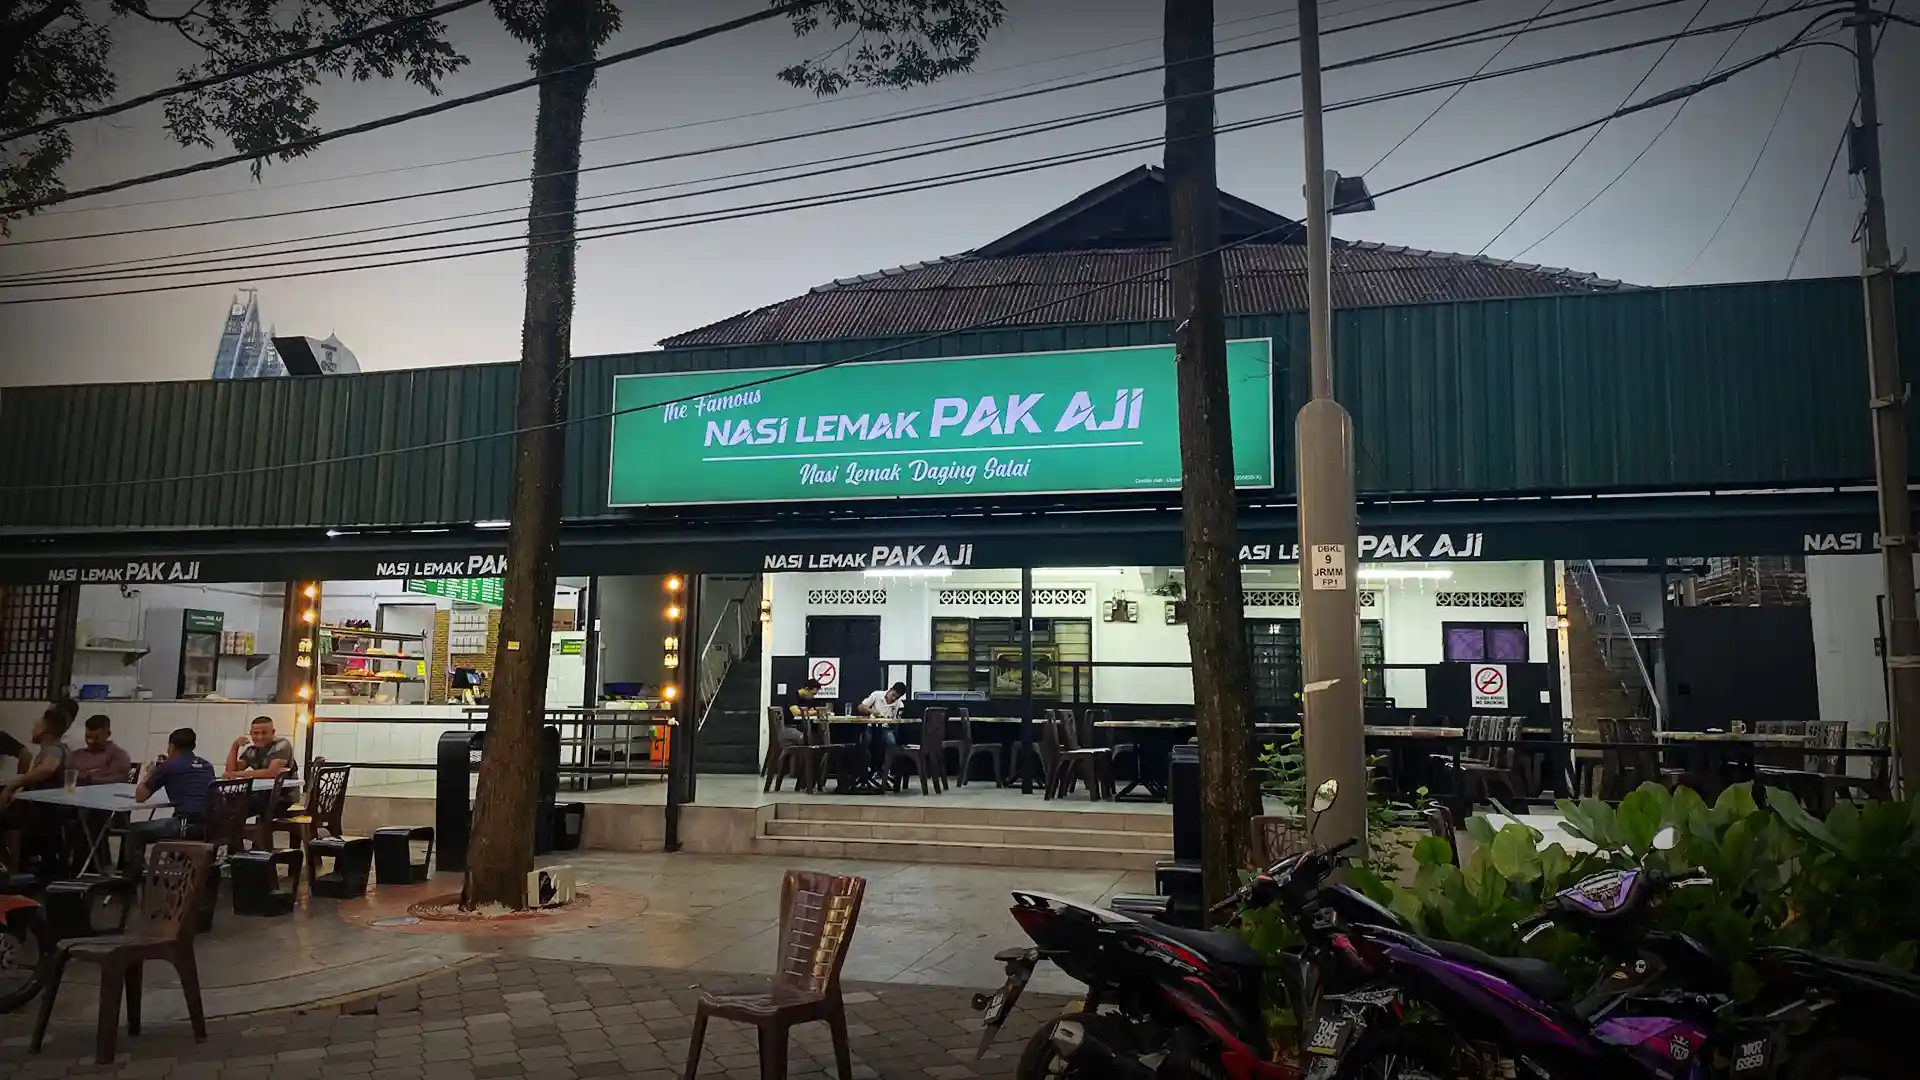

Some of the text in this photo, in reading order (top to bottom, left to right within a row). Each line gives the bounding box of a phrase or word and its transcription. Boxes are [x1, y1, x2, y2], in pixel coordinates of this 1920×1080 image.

[661, 389, 761, 424] The Famous
[704, 388, 1144, 447] NASI LEMAK PAK AJI
[799, 457, 1032, 486] Nasi Lemak Daging Salai
[1318, 545, 1341, 553] DBKL
[1357, 533, 1483, 559] PAK AJI
[1803, 532, 1863, 551] NASI
[764, 544, 973, 569] NASI LEMAK PAK AJI
[1238, 544, 1270, 560] ASI
[1325, 554, 1332, 564] 9
[48, 561, 200, 581] NASI LEMAK PAK AJI
[376, 562, 409, 576] NASI
[414, 561, 465, 575] LEMAK
[1314, 568, 1343, 577] JRMM
